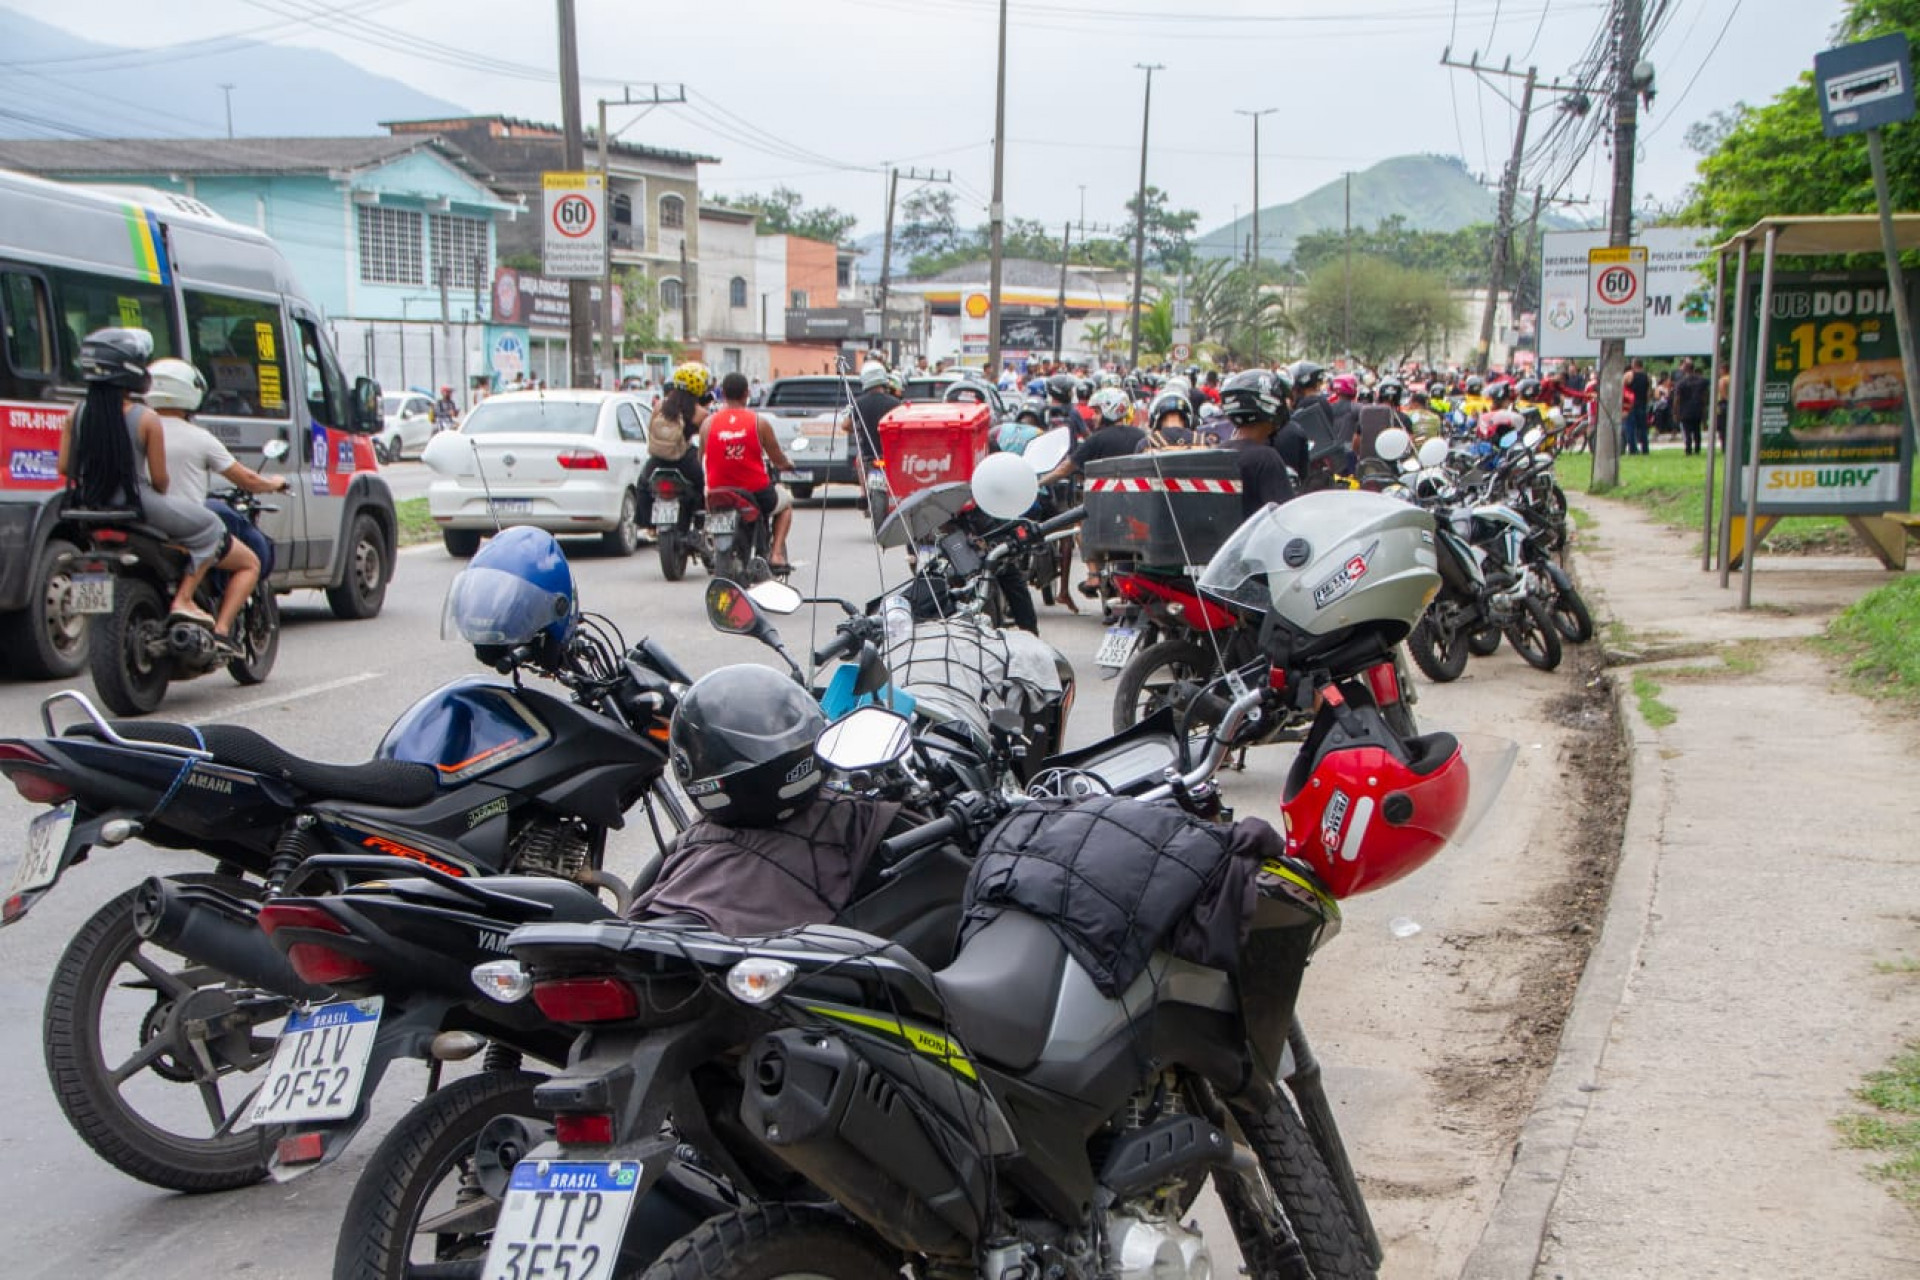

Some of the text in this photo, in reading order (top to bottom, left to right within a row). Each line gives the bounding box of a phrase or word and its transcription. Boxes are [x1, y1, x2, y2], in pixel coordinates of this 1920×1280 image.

[562, 201, 587, 224] 60
[1545, 257, 1588, 265] SECRETARI
[1606, 272, 1630, 293] 60
[1813, 290, 1853, 317] DO
[1790, 321, 1858, 370] 18
[902, 454, 953, 475] ifood
[1766, 468, 1879, 490] SUBWAY
[188, 773, 232, 794] AMAHA
[313, 1011, 348, 1028] BRASIL
[291, 1025, 353, 1068] RIV
[267, 1066, 350, 1111] 9F52
[550, 1172, 598, 1188] BRASIL
[531, 1192, 603, 1239] TTP
